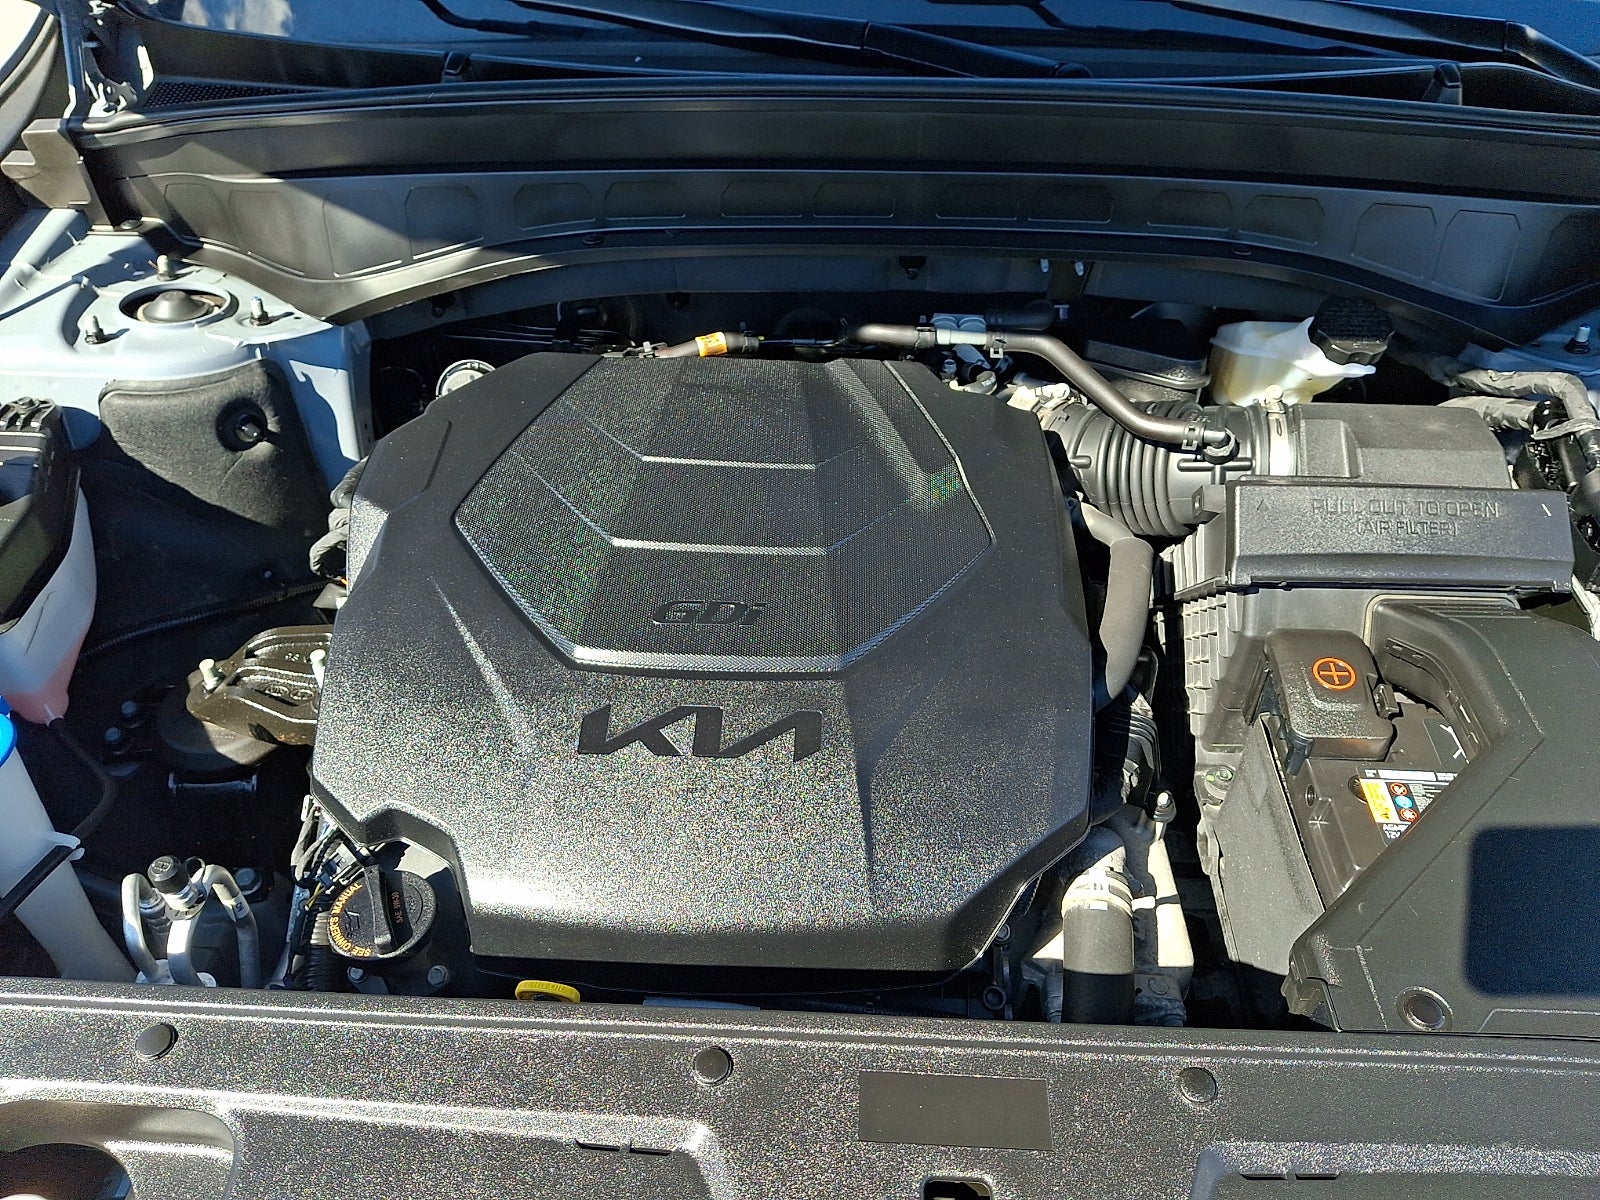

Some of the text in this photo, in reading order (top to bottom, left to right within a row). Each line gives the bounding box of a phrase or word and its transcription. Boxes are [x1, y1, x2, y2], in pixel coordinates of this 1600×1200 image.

[1311, 499, 1501, 517] PULL OUT TO OPEN
[578, 703, 823, 763] KIA
[329, 881, 372, 957] SEE OWNER'S MANUAL
